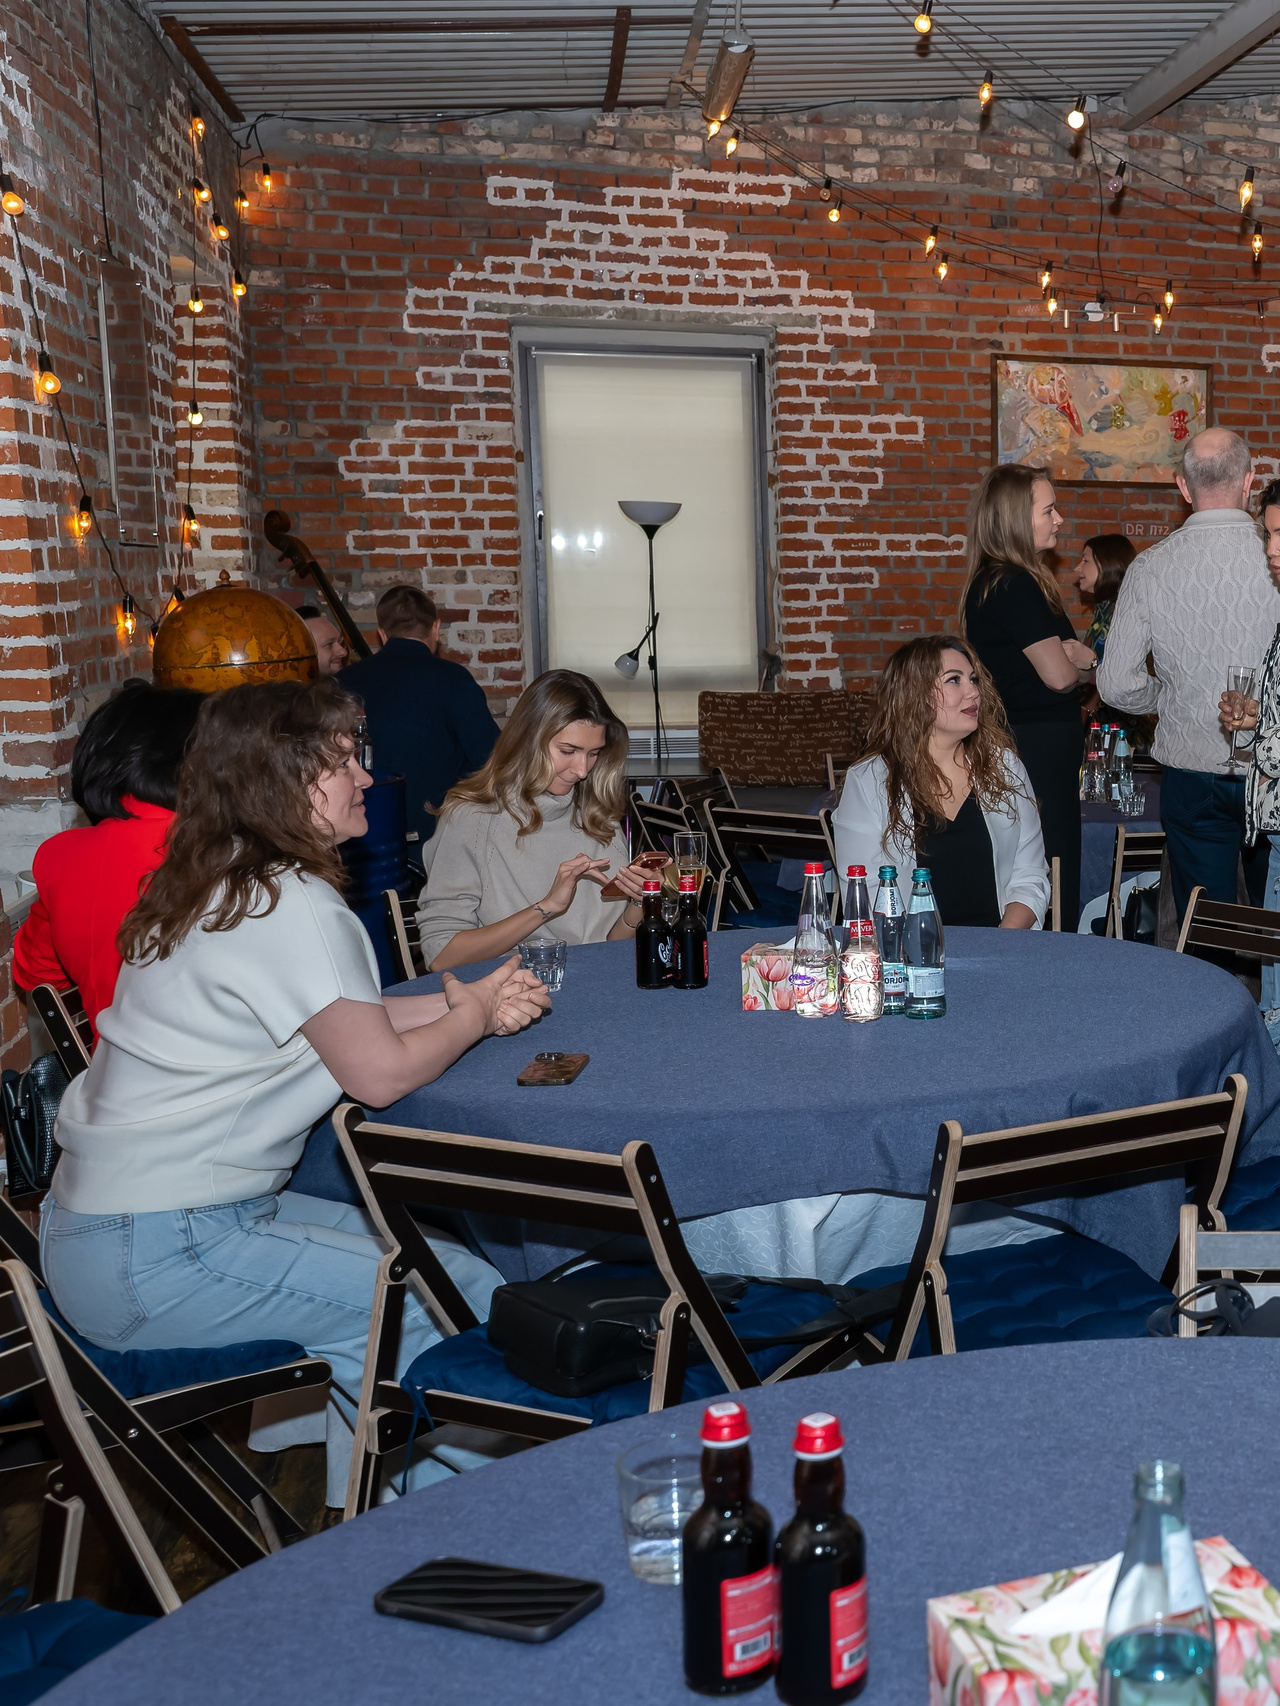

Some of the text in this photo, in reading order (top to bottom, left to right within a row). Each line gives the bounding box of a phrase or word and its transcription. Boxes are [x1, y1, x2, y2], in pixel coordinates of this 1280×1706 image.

[1126, 523, 1144, 536] DR
[889, 889, 897, 916] BORJOMI
[884, 976, 906, 985] ORJO
